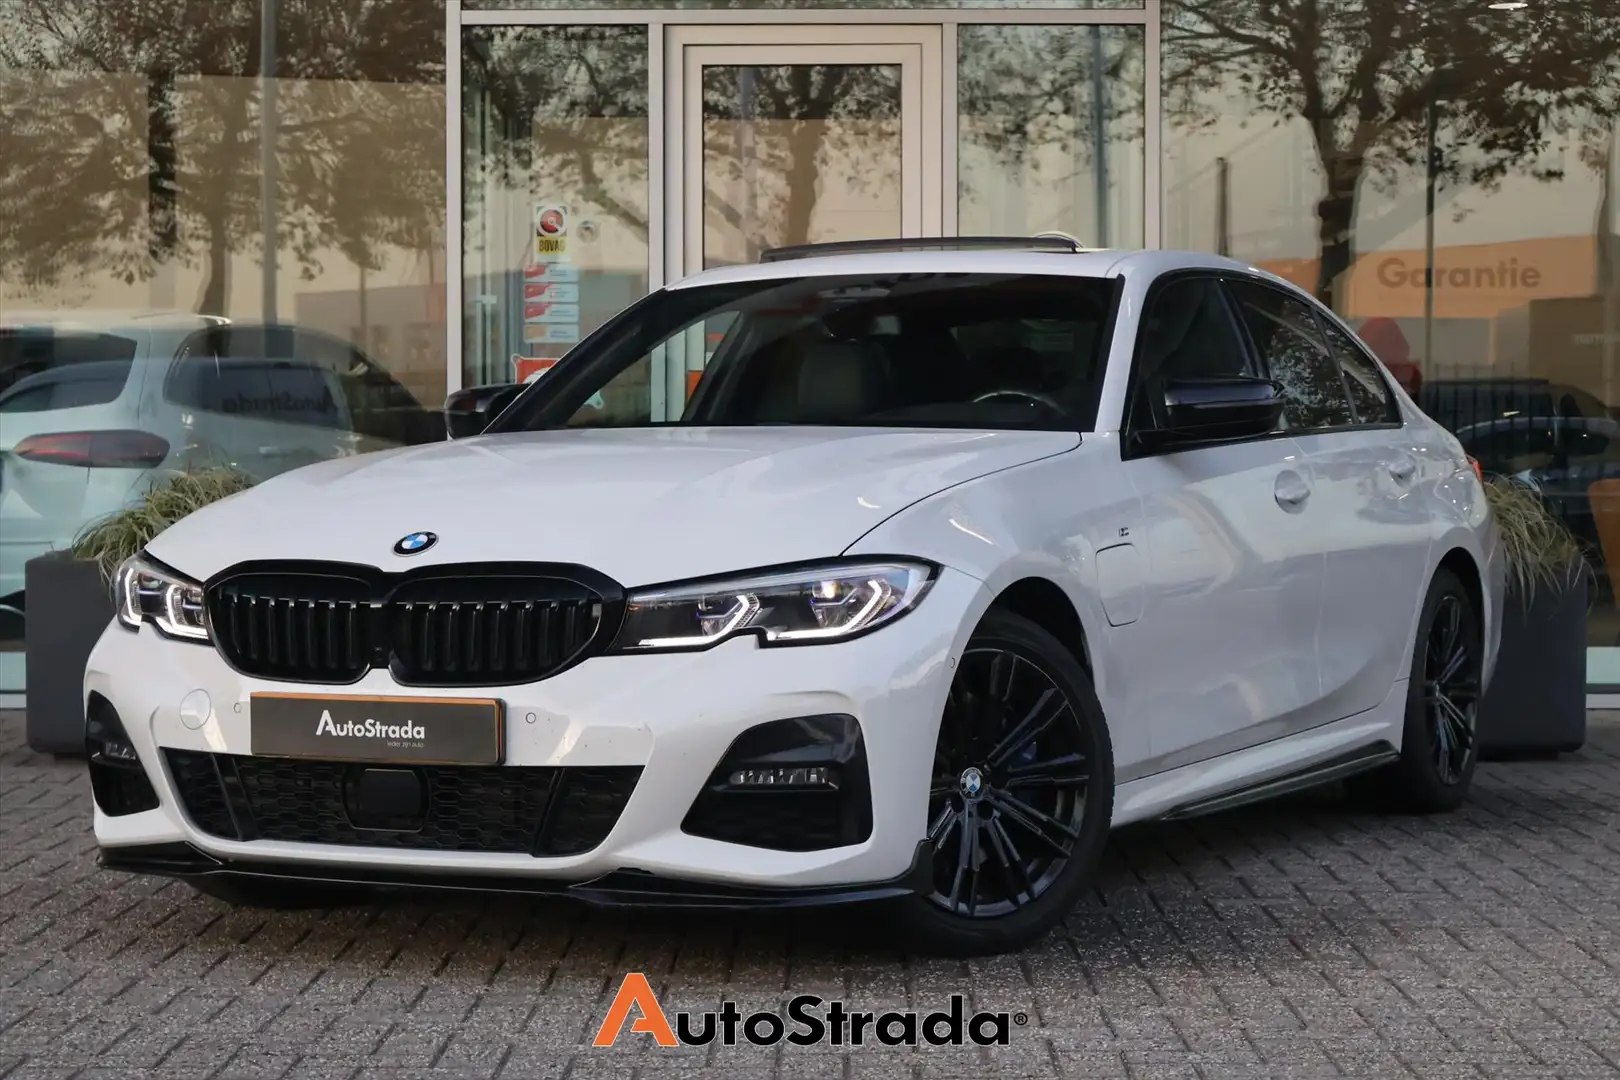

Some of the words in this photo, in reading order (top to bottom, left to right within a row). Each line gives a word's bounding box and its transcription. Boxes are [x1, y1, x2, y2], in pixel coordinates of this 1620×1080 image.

[539, 239, 566, 252] BOVAG
[1377, 257, 1541, 289] Garantie
[315, 710, 425, 739] AutoStrada
